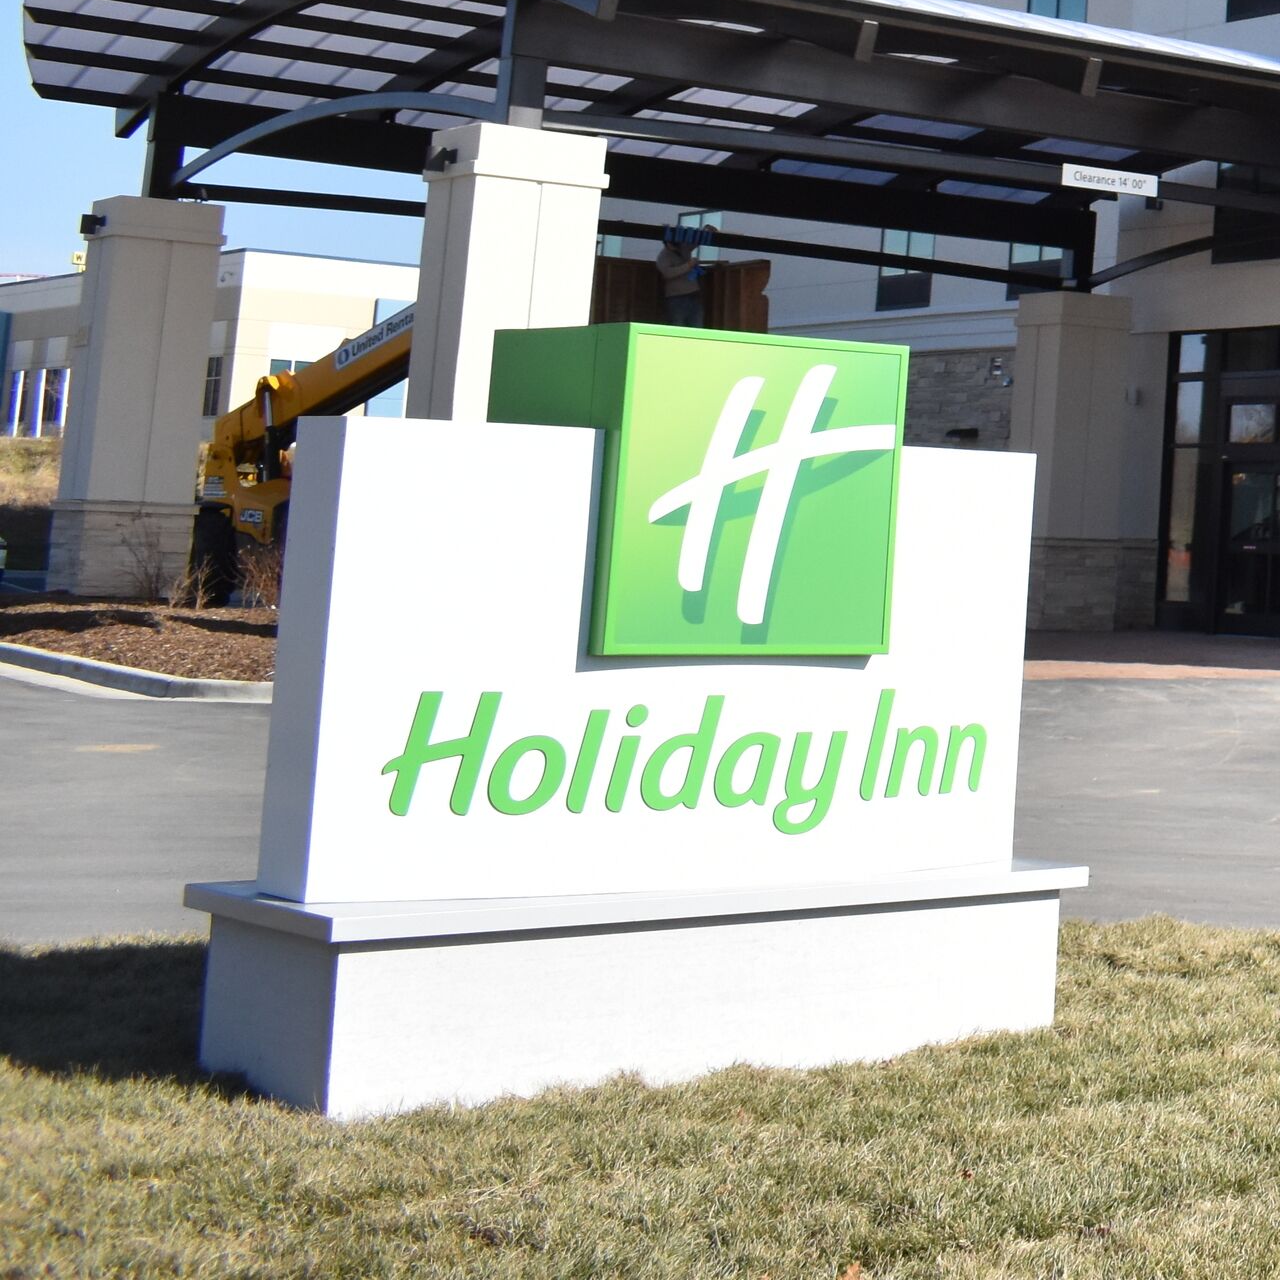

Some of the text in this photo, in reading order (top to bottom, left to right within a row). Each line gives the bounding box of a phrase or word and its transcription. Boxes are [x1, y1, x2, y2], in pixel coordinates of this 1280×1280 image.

[1073, 170, 1117, 186] Clearance
[351, 327, 384, 357] United
[240, 509, 263, 524] JCB
[380, 687, 989, 836] Holiday Inn
